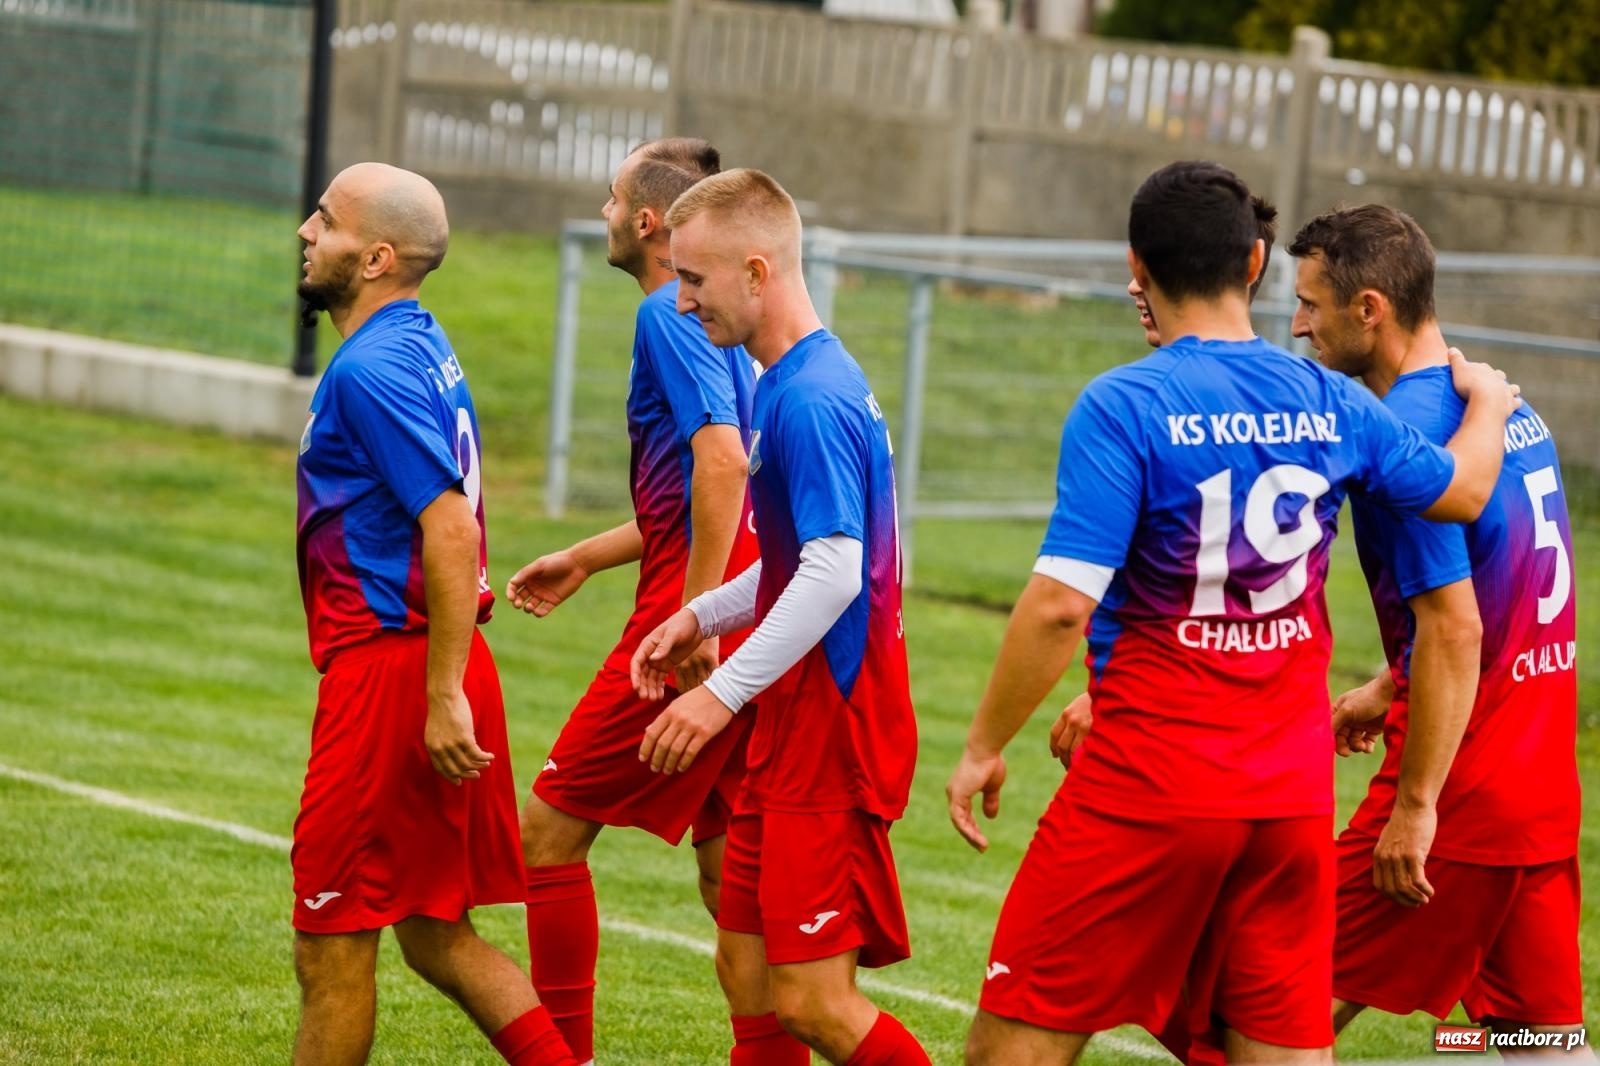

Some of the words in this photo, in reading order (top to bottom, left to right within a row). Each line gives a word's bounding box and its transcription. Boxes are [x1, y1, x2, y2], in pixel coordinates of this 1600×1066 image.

[1167, 414, 1206, 446] KS
[1210, 411, 1342, 445] KOLEJARZ
[1188, 464, 1331, 617] 19
[1523, 465, 1571, 624] 5
